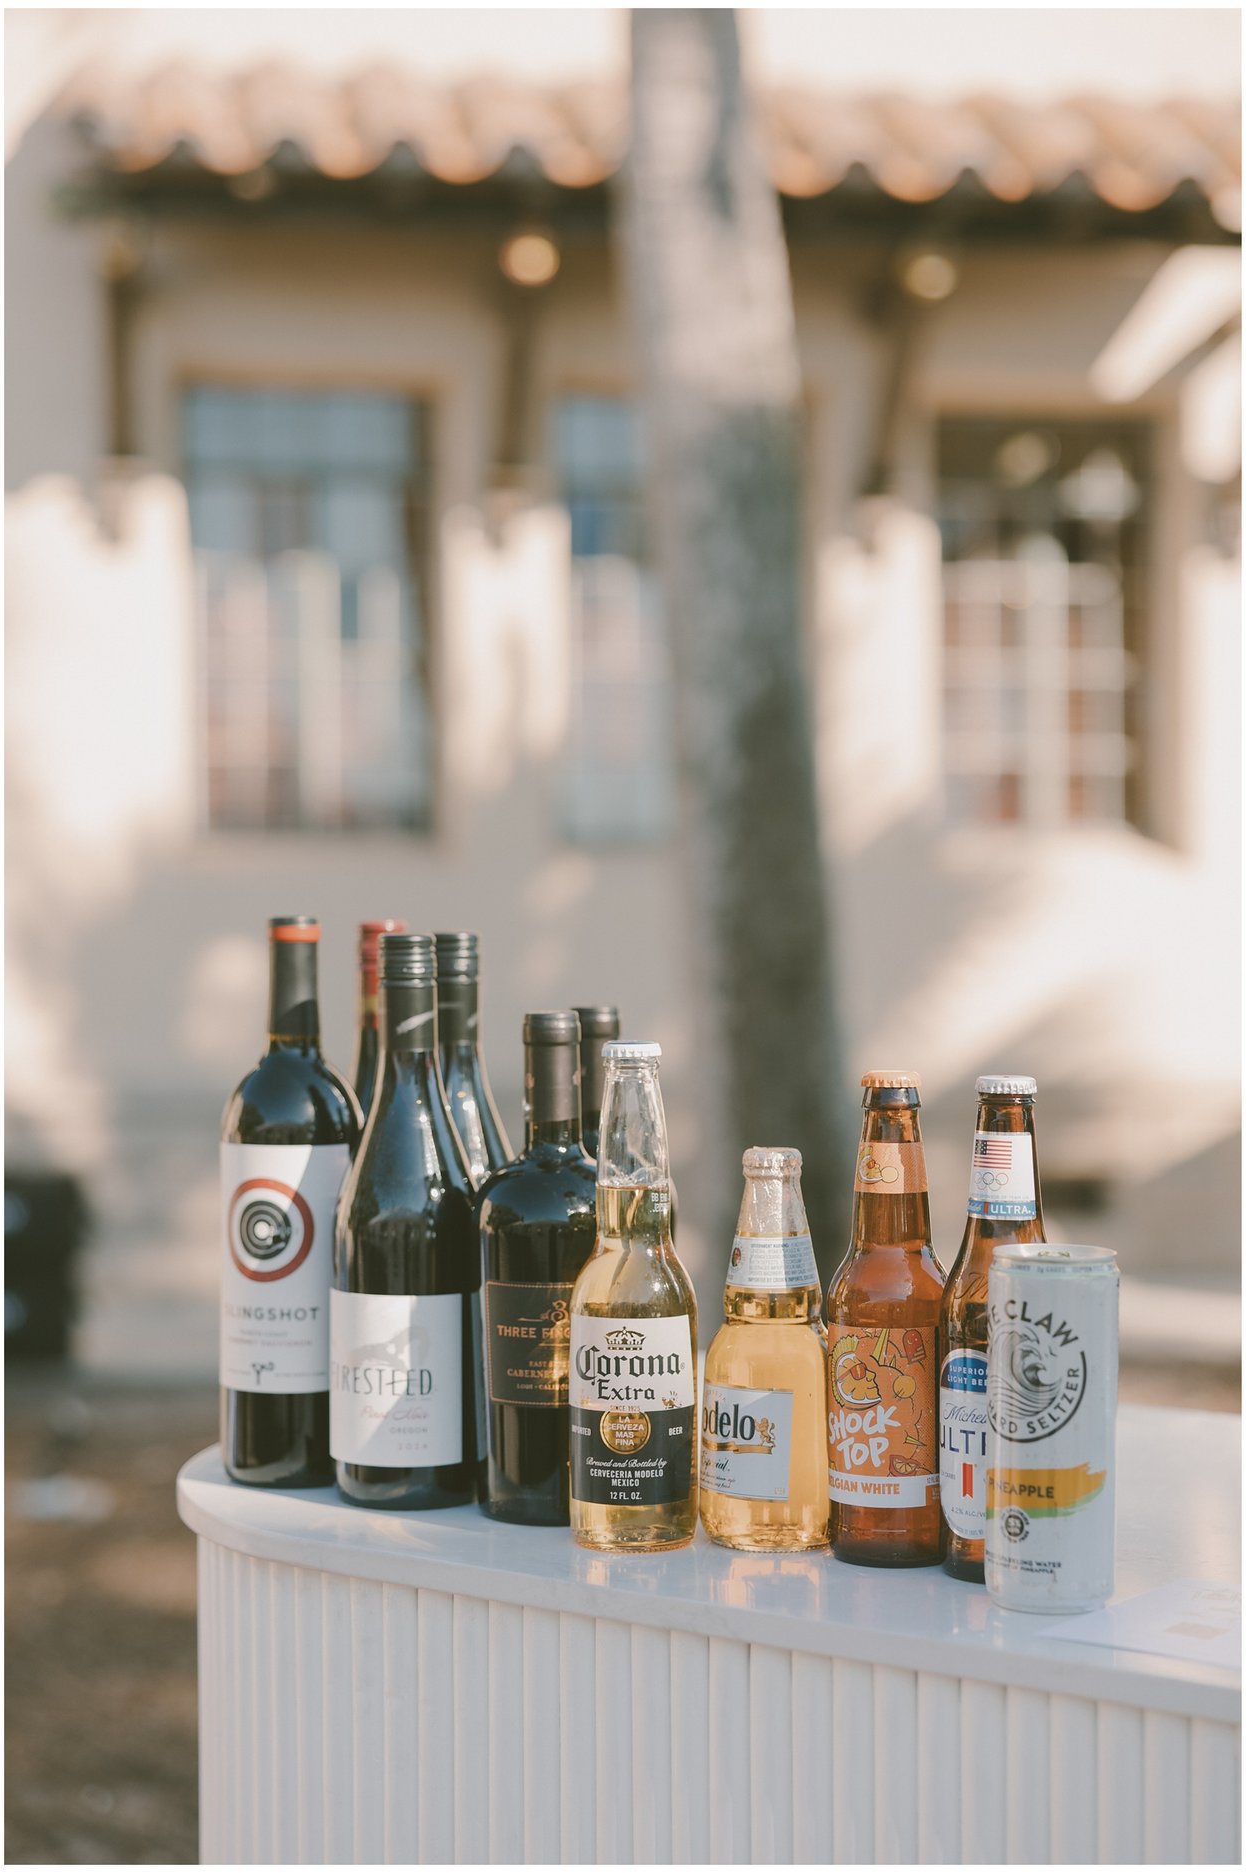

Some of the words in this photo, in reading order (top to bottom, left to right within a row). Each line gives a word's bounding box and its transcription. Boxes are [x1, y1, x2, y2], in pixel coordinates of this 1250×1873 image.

[991, 1203, 1029, 1214] ULTRA
[1005, 1299, 1079, 1347] CLAW
[496, 1324, 537, 1338] THREE
[576, 1344, 681, 1386] Corona
[947, 1375, 968, 1384] LIGHT
[597, 1378, 655, 1401] Extra
[1026, 1367, 1080, 1434] SELTZER
[607, 1423, 644, 1431] CERVEZA
[828, 1405, 901, 1444] SHOCK
[615, 1431, 634, 1439] MAS
[668, 1426, 683, 1436] BEER
[837, 1437, 889, 1470] TOP
[585, 1456, 611, 1467] Brewed
[612, 1459, 627, 1467] and
[628, 1458, 657, 1468] Bottled
[590, 1468, 632, 1478] CERVECERIA
[635, 1469, 664, 1478] MODELO
[611, 1478, 640, 1487] MEXICO
[861, 1482, 900, 1495] WHITE
[610, 1492, 617, 1500] 12
[619, 1492, 629, 1500] FL.
[631, 1492, 642, 1500] OZ.
